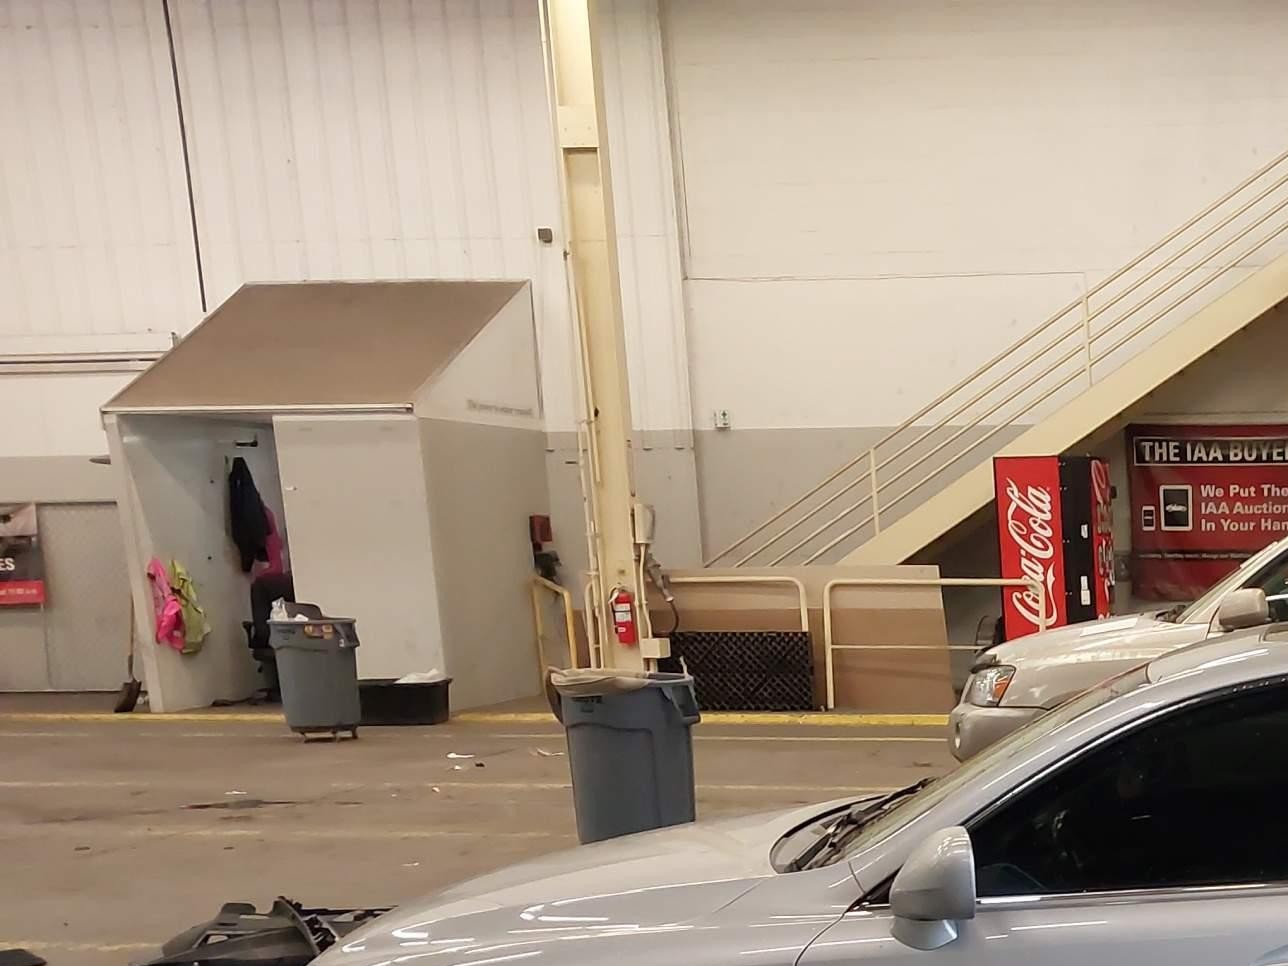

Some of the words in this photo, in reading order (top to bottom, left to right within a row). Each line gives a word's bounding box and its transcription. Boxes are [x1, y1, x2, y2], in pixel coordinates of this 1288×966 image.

[1140, 441, 1180, 463] THE
[1186, 441, 1224, 463] IAA
[1200, 484, 1225, 498] We
[1229, 484, 1256, 498] Put
[1201, 501, 1230, 515] IAA
[1201, 518, 1216, 532] In
[1220, 518, 1256, 532] Your
